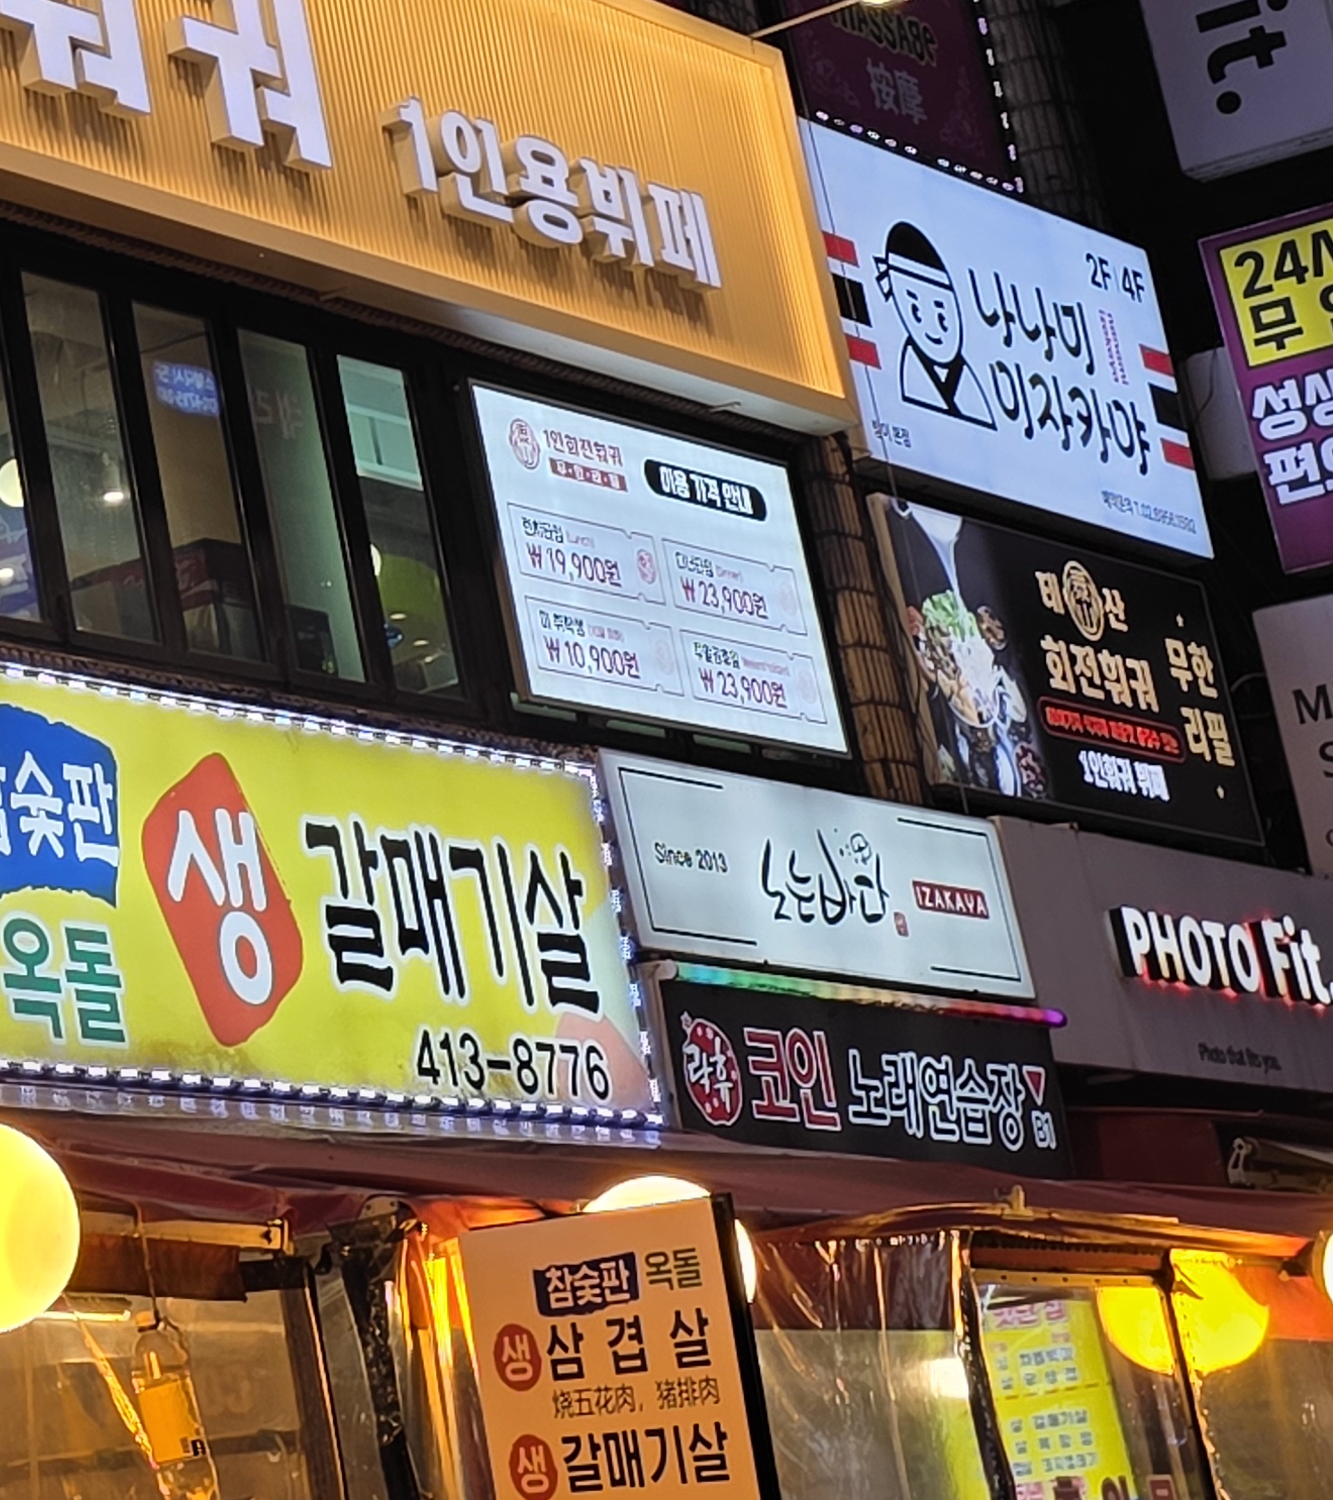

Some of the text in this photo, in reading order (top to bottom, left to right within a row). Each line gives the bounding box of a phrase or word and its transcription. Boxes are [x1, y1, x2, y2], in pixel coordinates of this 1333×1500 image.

[393, 96, 723, 289] 1인용뷔페
[1085, 252, 1145, 304] 2F 4F
[967, 267, 1096, 376] 나나미
[987, 362, 1151, 476] 이자카야
[1164, 637, 1219, 699] 무한
[1180, 706, 1236, 767] 리필
[653, 841, 729, 874] Since 2013
[167, 806, 276, 1007] 생
[302, 816, 603, 1018] 갈매기살
[915, 883, 989, 917] IZAKAYA
[1, 914, 127, 1043] 옥돌
[1119, 905, 1333, 1005] PHOTO Fit
[416, 1029, 611, 1100] 413-8776
[743, 1026, 842, 1132] 코인
[847, 1047, 1026, 1152] 노래연습장
[1033, 1109, 1057, 1150] B1
[544, 1246, 703, 1310] 참숯판 옥돌
[501, 1307, 712, 1383] 생 삼겹살
[516, 1421, 731, 1495] 생 갈매기살
